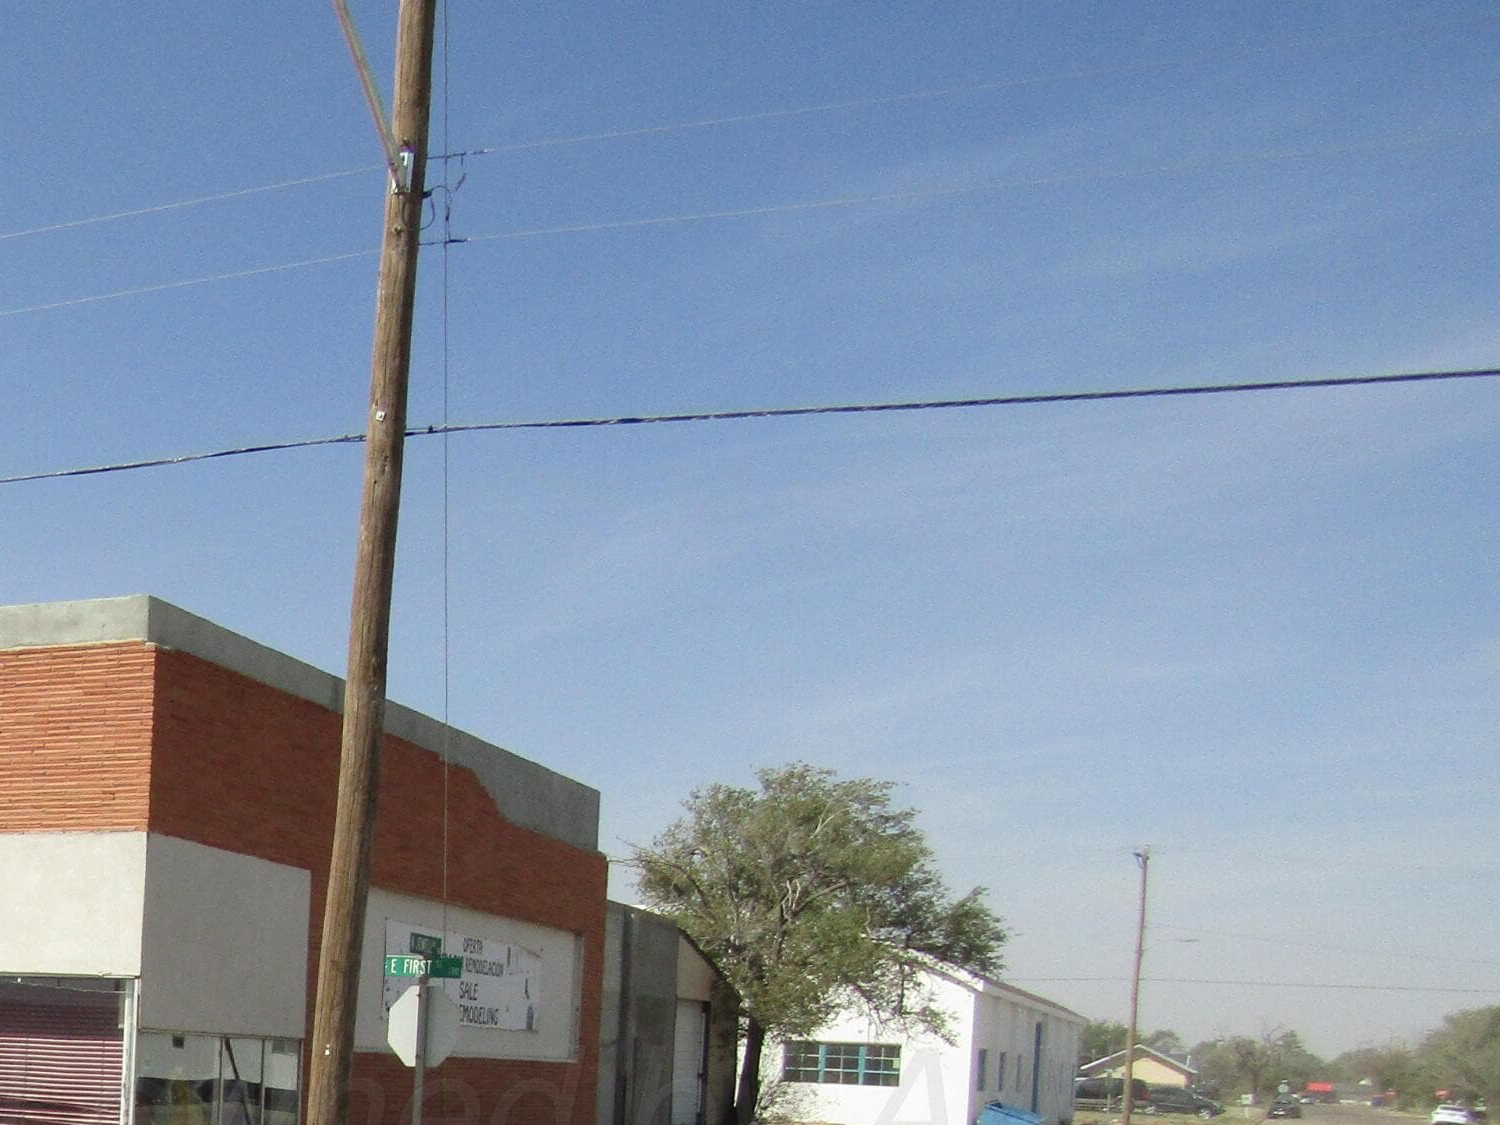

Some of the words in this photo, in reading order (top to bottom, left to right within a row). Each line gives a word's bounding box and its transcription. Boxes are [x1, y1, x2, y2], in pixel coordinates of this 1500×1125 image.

[390, 958, 397, 974] E
[403, 958, 432, 975] FIRST
[459, 1003, 499, 1026] EMODELING
